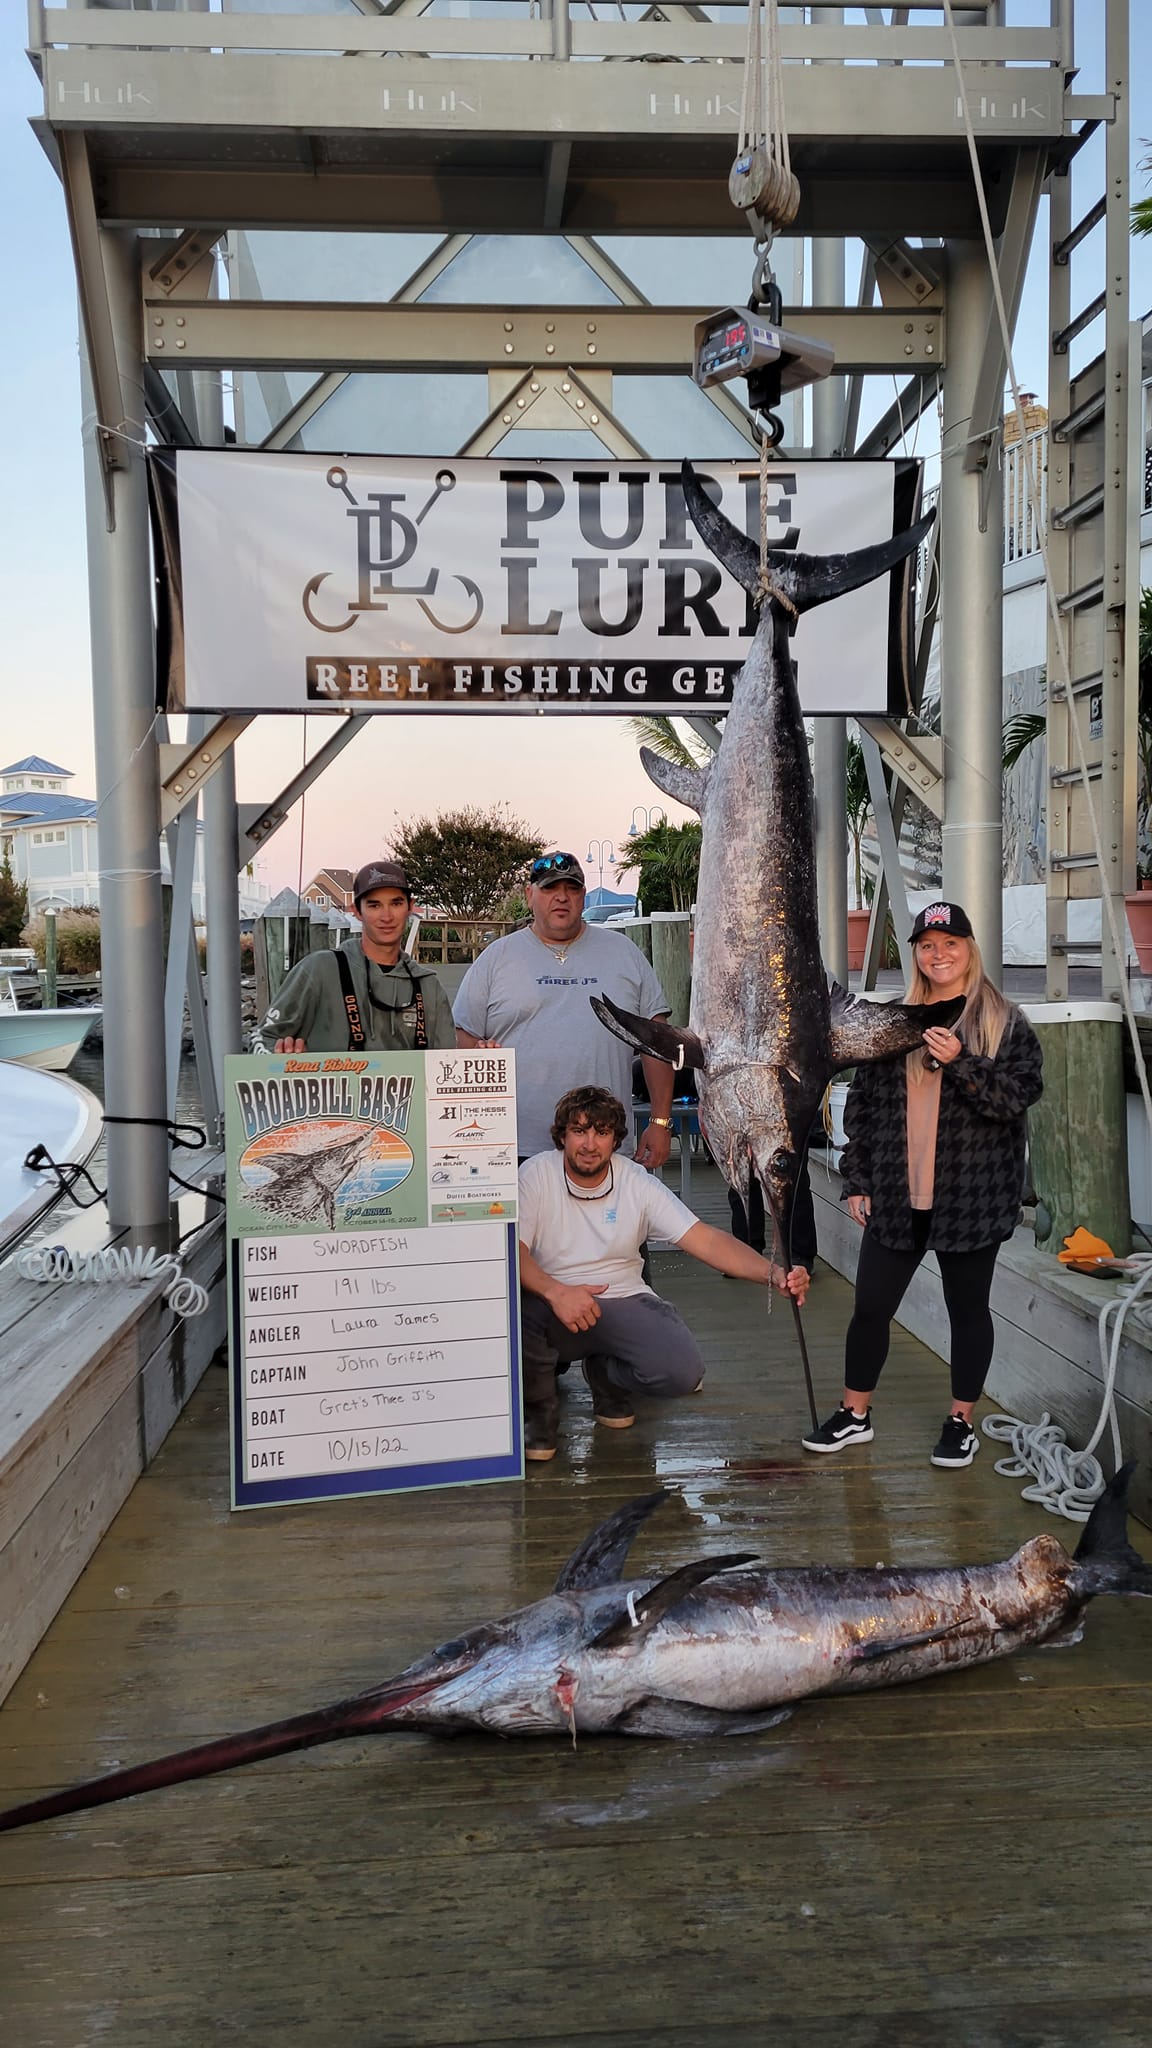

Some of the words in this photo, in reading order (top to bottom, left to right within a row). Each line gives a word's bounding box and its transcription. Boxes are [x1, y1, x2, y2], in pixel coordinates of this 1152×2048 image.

[500, 470, 801, 550] PURE
[500, 557, 799, 637] LUR
[315, 664, 429, 693] REEL
[453, 665, 648, 694] FISHING
[344, 995, 365, 1043] GRUND
[284, 1059, 320, 1073] Rena
[321, 1057, 369, 1074] Bishop
[463, 1059, 507, 1072] PURE
[463, 1071, 507, 1084] LURE
[235, 1075, 355, 1141] BROADBILL
[357, 1074, 415, 1135] BASH
[361, 1207, 393, 1217] ANNUAL
[247, 1246, 278, 1262] FISH
[312, 1237, 409, 1257] SWORDFISH
[248, 1284, 300, 1303] WEIGHT
[334, 1277, 360, 1297] 191
[331, 1318, 380, 1335] Laura
[394, 1312, 440, 1327] James
[248, 1326, 301, 1344] ANGLER
[336, 1355, 380, 1373] John
[386, 1349, 445, 1367] Griffith
[250, 1365, 307, 1384] CAPTAIN
[251, 1408, 286, 1426] BOAT
[327, 1435, 409, 1462] 10/15/22
[251, 1450, 285, 1469] DATE
